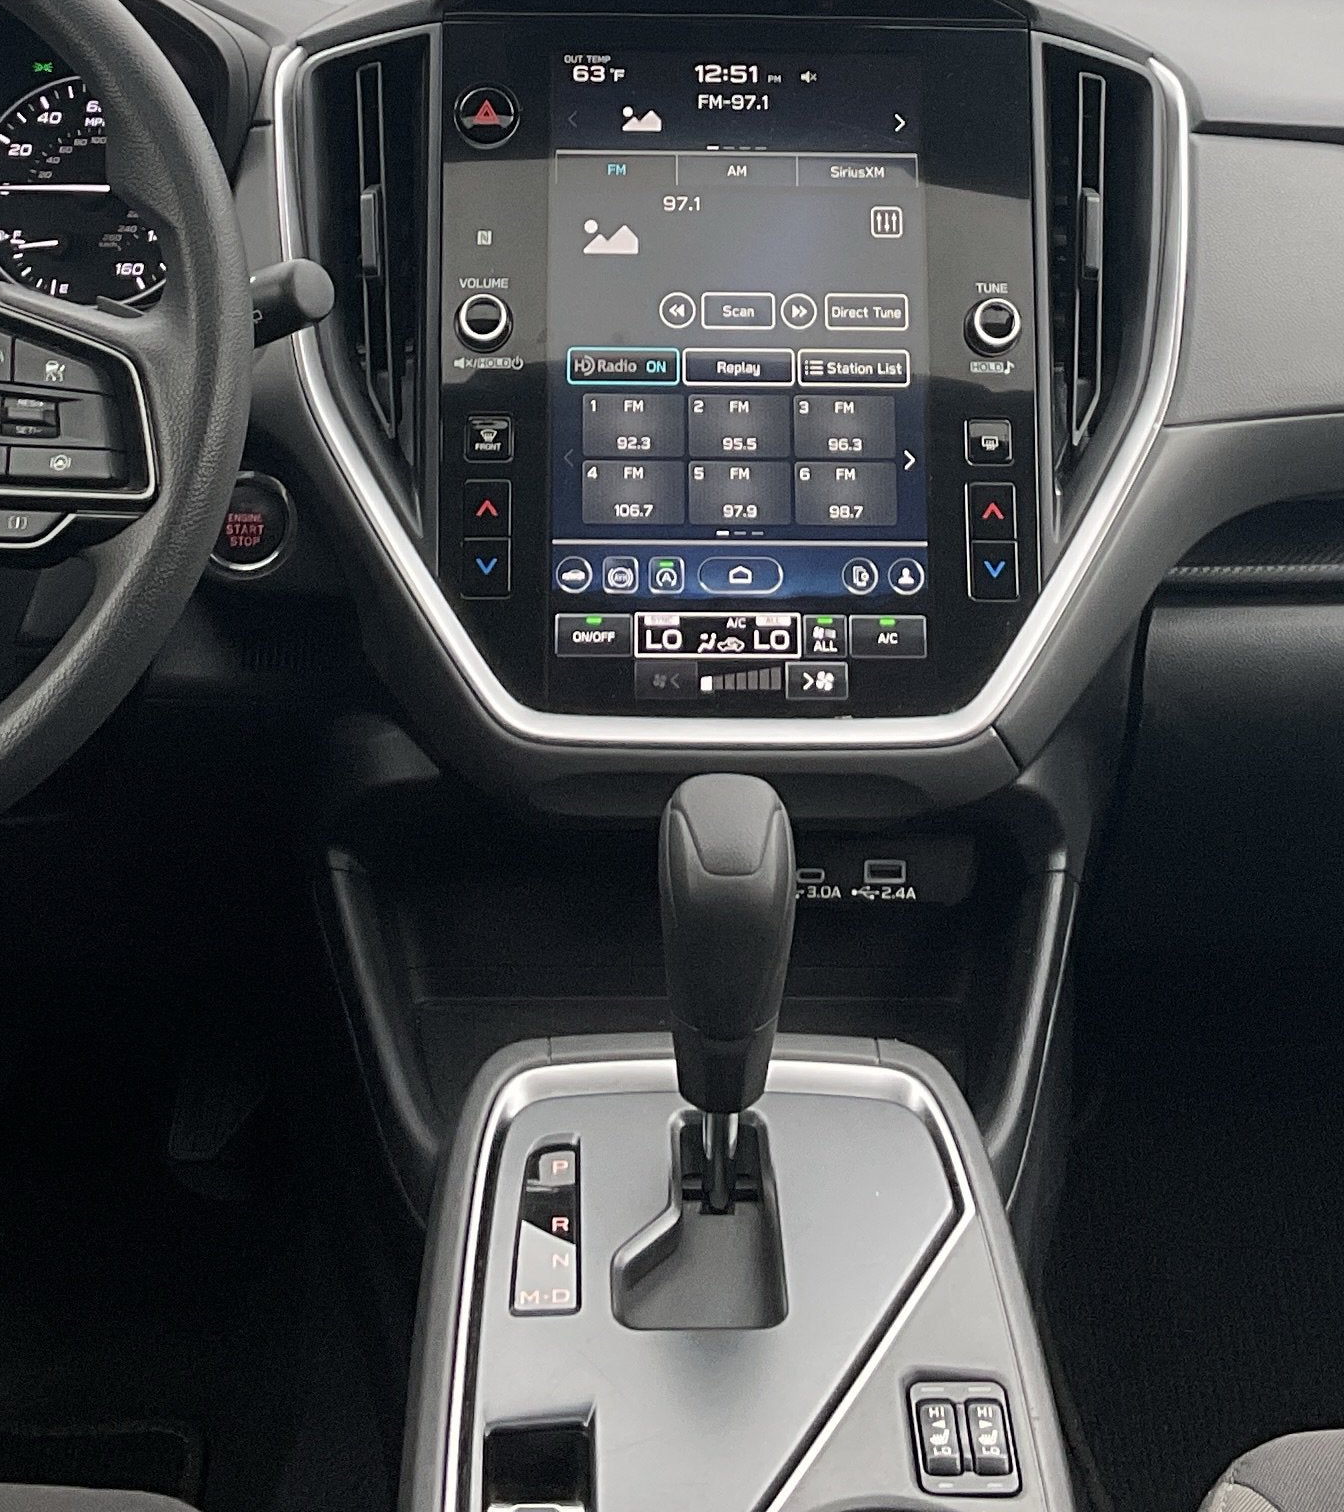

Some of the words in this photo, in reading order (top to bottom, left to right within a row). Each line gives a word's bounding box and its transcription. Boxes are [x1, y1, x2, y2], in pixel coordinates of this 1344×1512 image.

[564, 54, 584, 64] OUT
[586, 54, 611, 65] TEMP
[572, 65, 605, 83] 63
[694, 64, 759, 84] 12:51
[767, 74, 782, 84] PM
[697, 94, 770, 111] FM-97.1
[36, 111, 62, 125] 40
[84, 117, 105, 127] MP
[8, 143, 32, 157] 20
[607, 163, 627, 176] FM
[726, 165, 748, 177] AM
[830, 166, 886, 179] SiriusXM
[663, 196, 702, 211] 97.1
[114, 262, 145, 276] 160
[459, 277, 509, 289] VOLUME
[975, 282, 1008, 294] TUNE
[722, 305, 755, 318] Scan
[831, 305, 868, 319] Direct
[872, 306, 902, 319] Tune
[597, 359, 637, 374] Radio
[646, 360, 667, 374] ON
[716, 360, 761, 377] Replay
[826, 361, 874, 376] Station
[877, 361, 903, 376] List
[970, 362, 1003, 373] HOLD
[590, 400, 598, 413] 1
[623, 400, 644, 413] FM
[693, 400, 704, 413] 2
[729, 400, 750, 413] FM
[798, 401, 810, 414] 3
[834, 401, 855, 414] FM
[475, 442, 501, 451] FRONT
[617, 436, 651, 451] 92.3
[722, 437, 758, 451] 95.5
[828, 437, 863, 451] 96.3
[586, 467, 598, 480] 4
[623, 467, 644, 480] FM
[693, 467, 705, 480] 5
[729, 467, 750, 480] FM
[799, 468, 810, 481] 6
[835, 468, 856, 481] FM
[613, 504, 654, 518] 106.7
[722, 505, 758, 519] 97.9
[829, 505, 864, 519] 98.7
[227, 513, 263, 523] ENGINE
[226, 524, 265, 535] START
[230, 536, 261, 547] STOP
[726, 617, 747, 629] A/C
[572, 630, 616, 644] ON/OFF
[645, 629, 683, 650] LO
[753, 629, 791, 651] LO
[877, 632, 899, 645] A/C
[813, 640, 838, 653] ALL
[806, 885, 842, 899] 3.0A
[881, 886, 917, 900] 2.4A
[552, 1160, 569, 1175] P
[551, 1216, 570, 1232] R
[552, 1253, 570, 1268] N
[928, 1406, 945, 1419] HI
[976, 1406, 993, 1418] HI
[932, 1446, 952, 1457] LO
[981, 1446, 1001, 1456] LO
